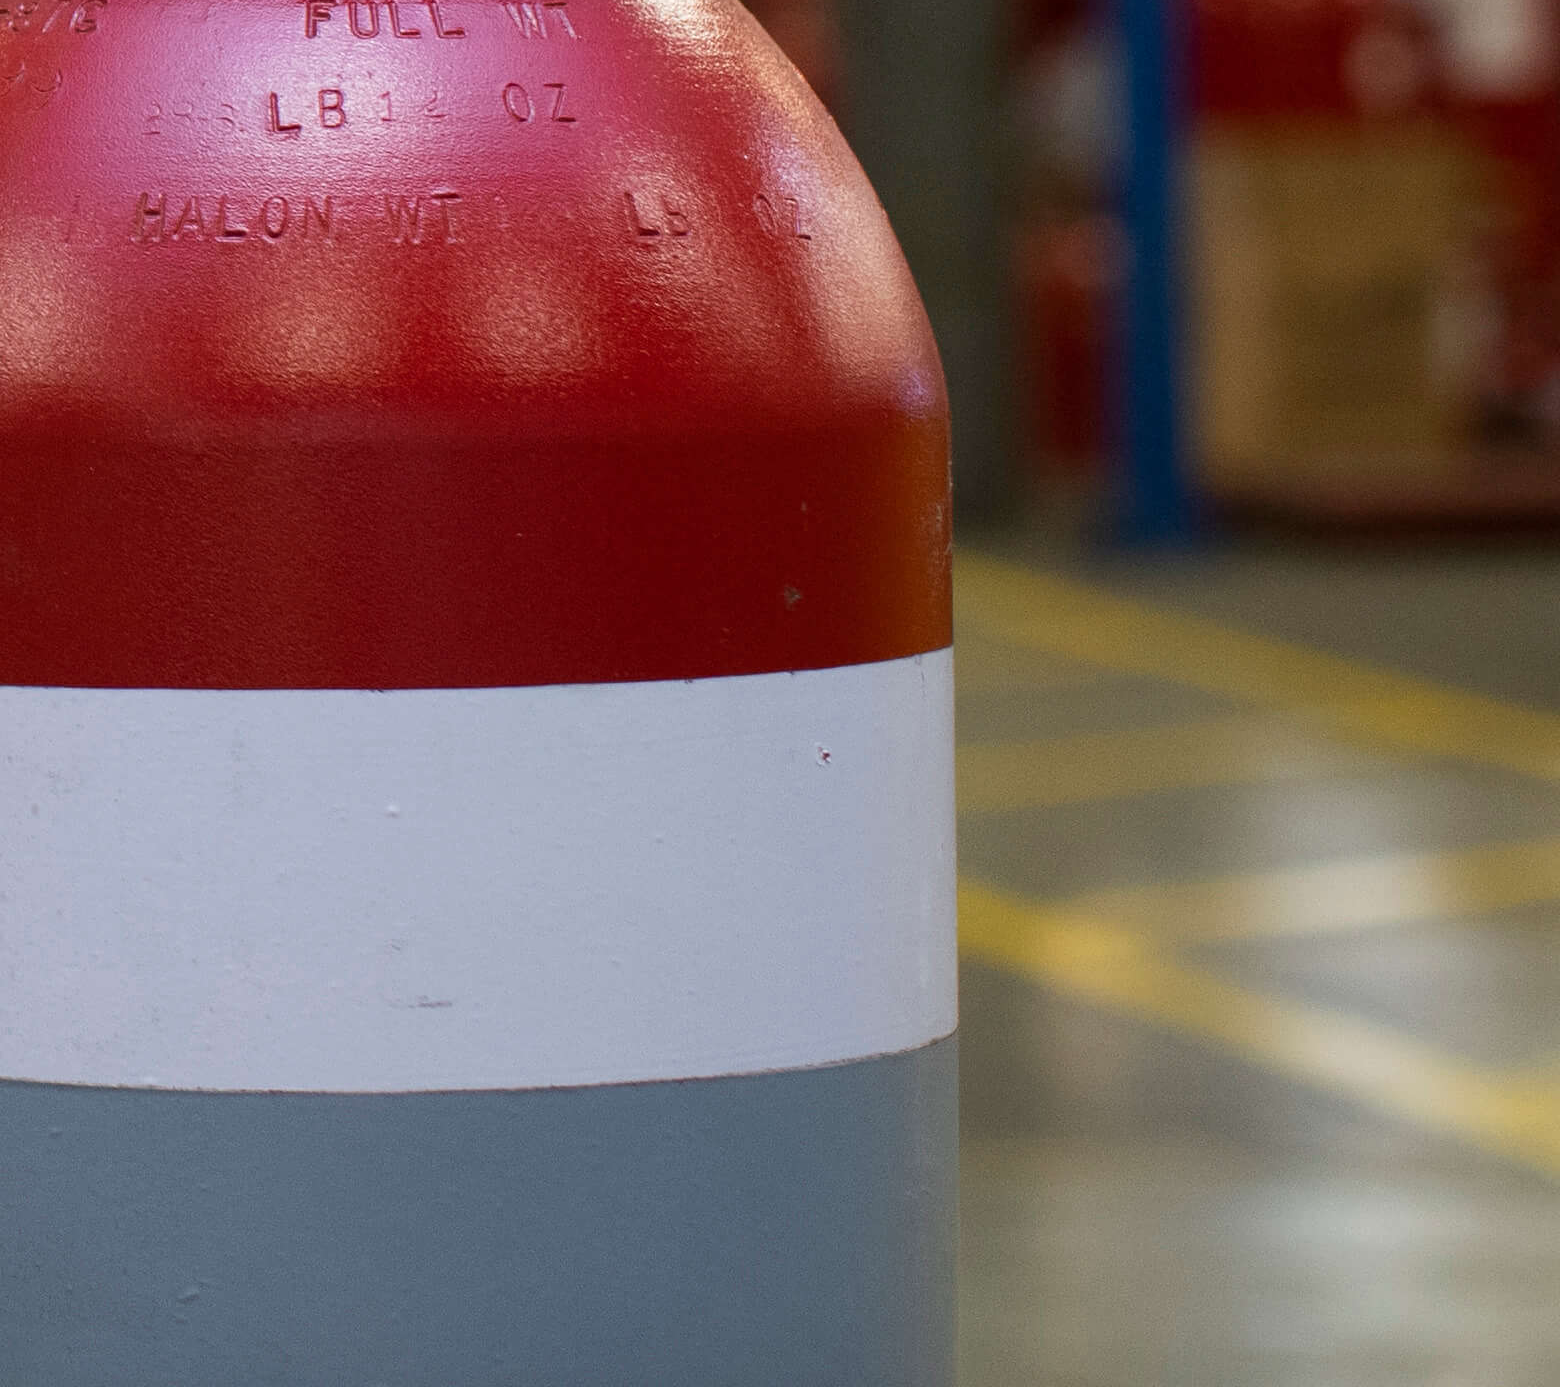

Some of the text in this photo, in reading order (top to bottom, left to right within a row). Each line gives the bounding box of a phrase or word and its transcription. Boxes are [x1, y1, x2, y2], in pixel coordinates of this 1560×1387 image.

[267, 88, 348, 135] LB
[502, 82, 577, 124] OZ
[129, 190, 342, 245] HALON
[383, 188, 466, 246] WT
